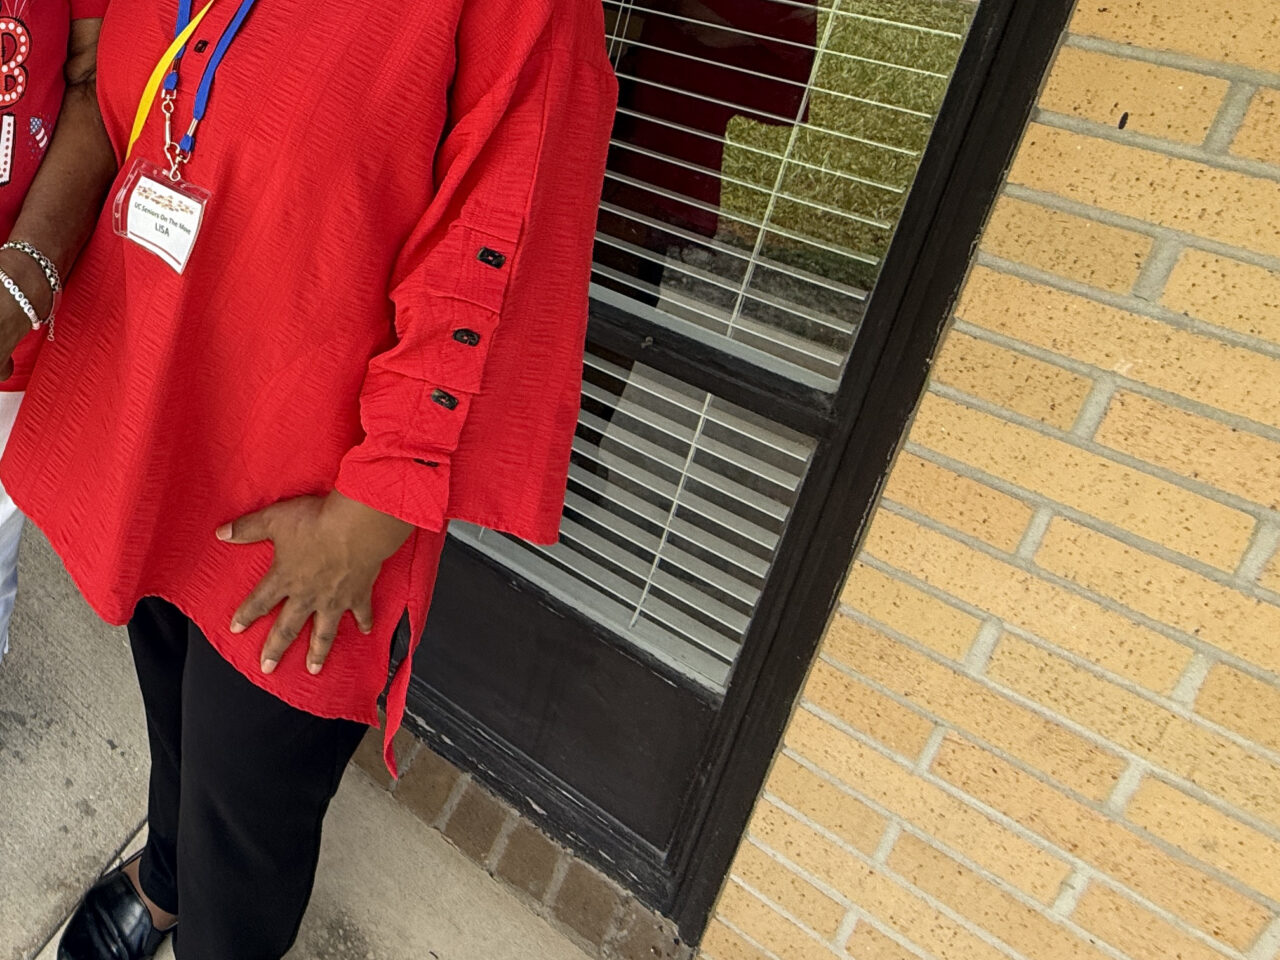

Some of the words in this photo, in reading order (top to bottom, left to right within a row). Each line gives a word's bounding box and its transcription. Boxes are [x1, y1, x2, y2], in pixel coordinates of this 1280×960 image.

[134, 201, 142, 210] UC
[141, 205, 159, 218] Seniors
[160, 214, 168, 222] On
[168, 217, 179, 228] The
[179, 223, 191, 235] Move
[154, 222, 169, 237] LISA
